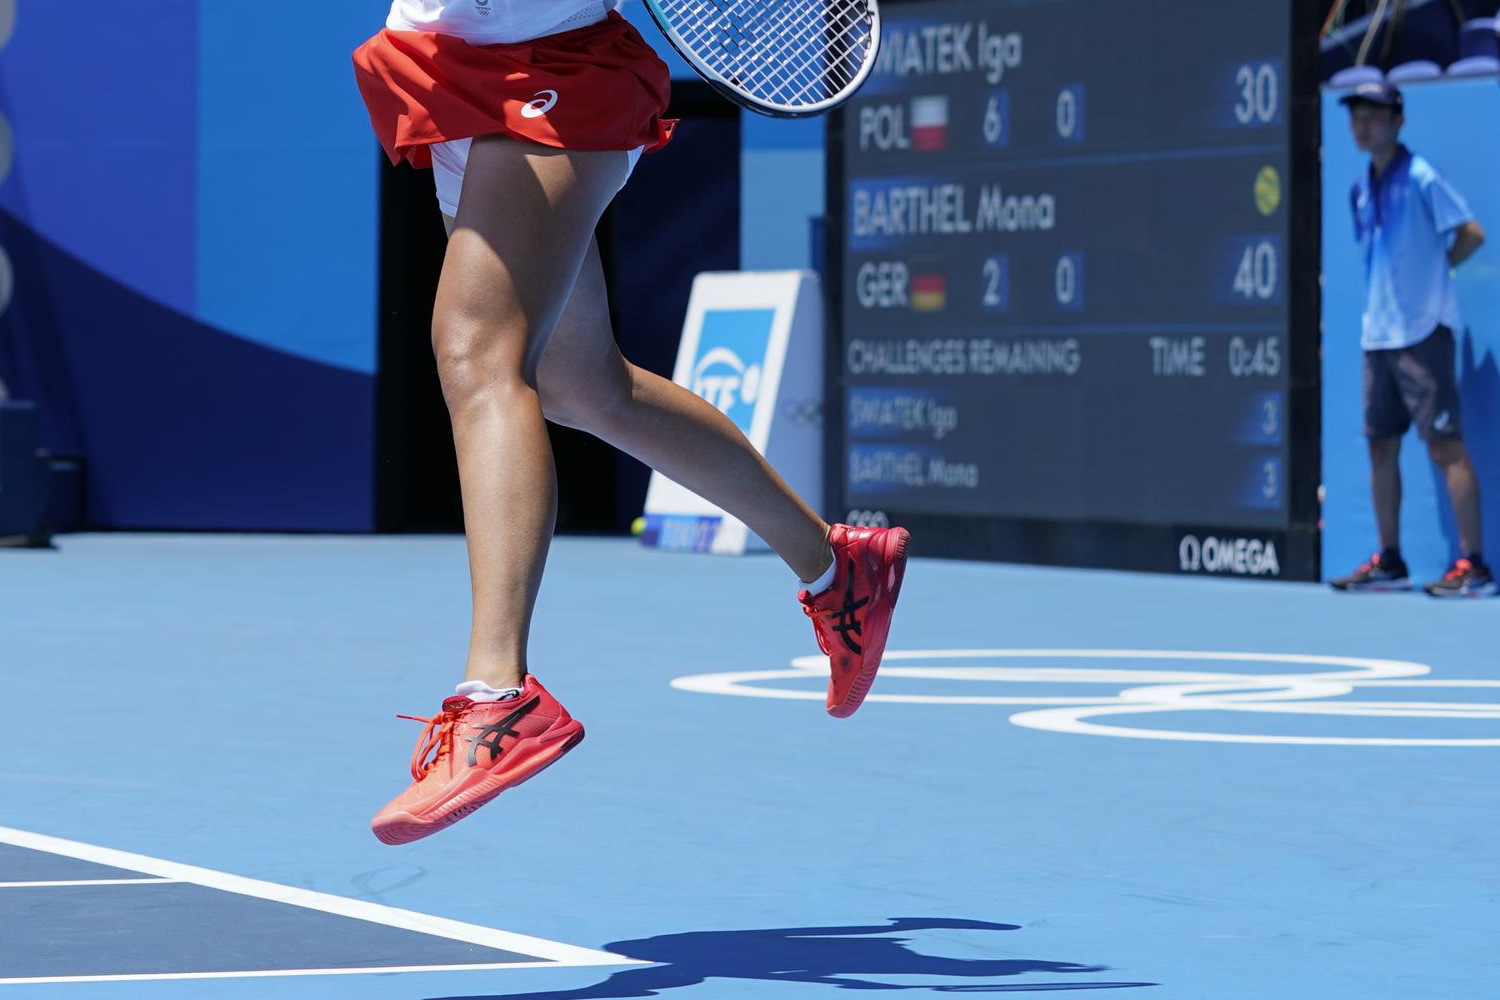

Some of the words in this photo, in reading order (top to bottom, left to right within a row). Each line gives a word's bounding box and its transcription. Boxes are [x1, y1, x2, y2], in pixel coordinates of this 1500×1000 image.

[876, 23, 973, 77] WIATEK
[978, 22, 1022, 85] Iga
[859, 104, 910, 151] POL
[983, 95, 1001, 144] 6
[1056, 88, 1077, 139] 0
[1234, 63, 1278, 125] 30
[853, 183, 972, 238] BARTHEL
[976, 183, 1056, 234] Mona
[856, 260, 909, 309] GER
[982, 257, 1001, 307] 2
[1055, 255, 1076, 304] 0
[1232, 240, 1277, 300] 40
[1150, 336, 1206, 377] TIME
[1228, 335, 1282, 377] 0:45
[1262, 398, 1279, 437] 3
[1261, 459, 1278, 500] 3
[1201, 536, 1280, 577] OMEGA
